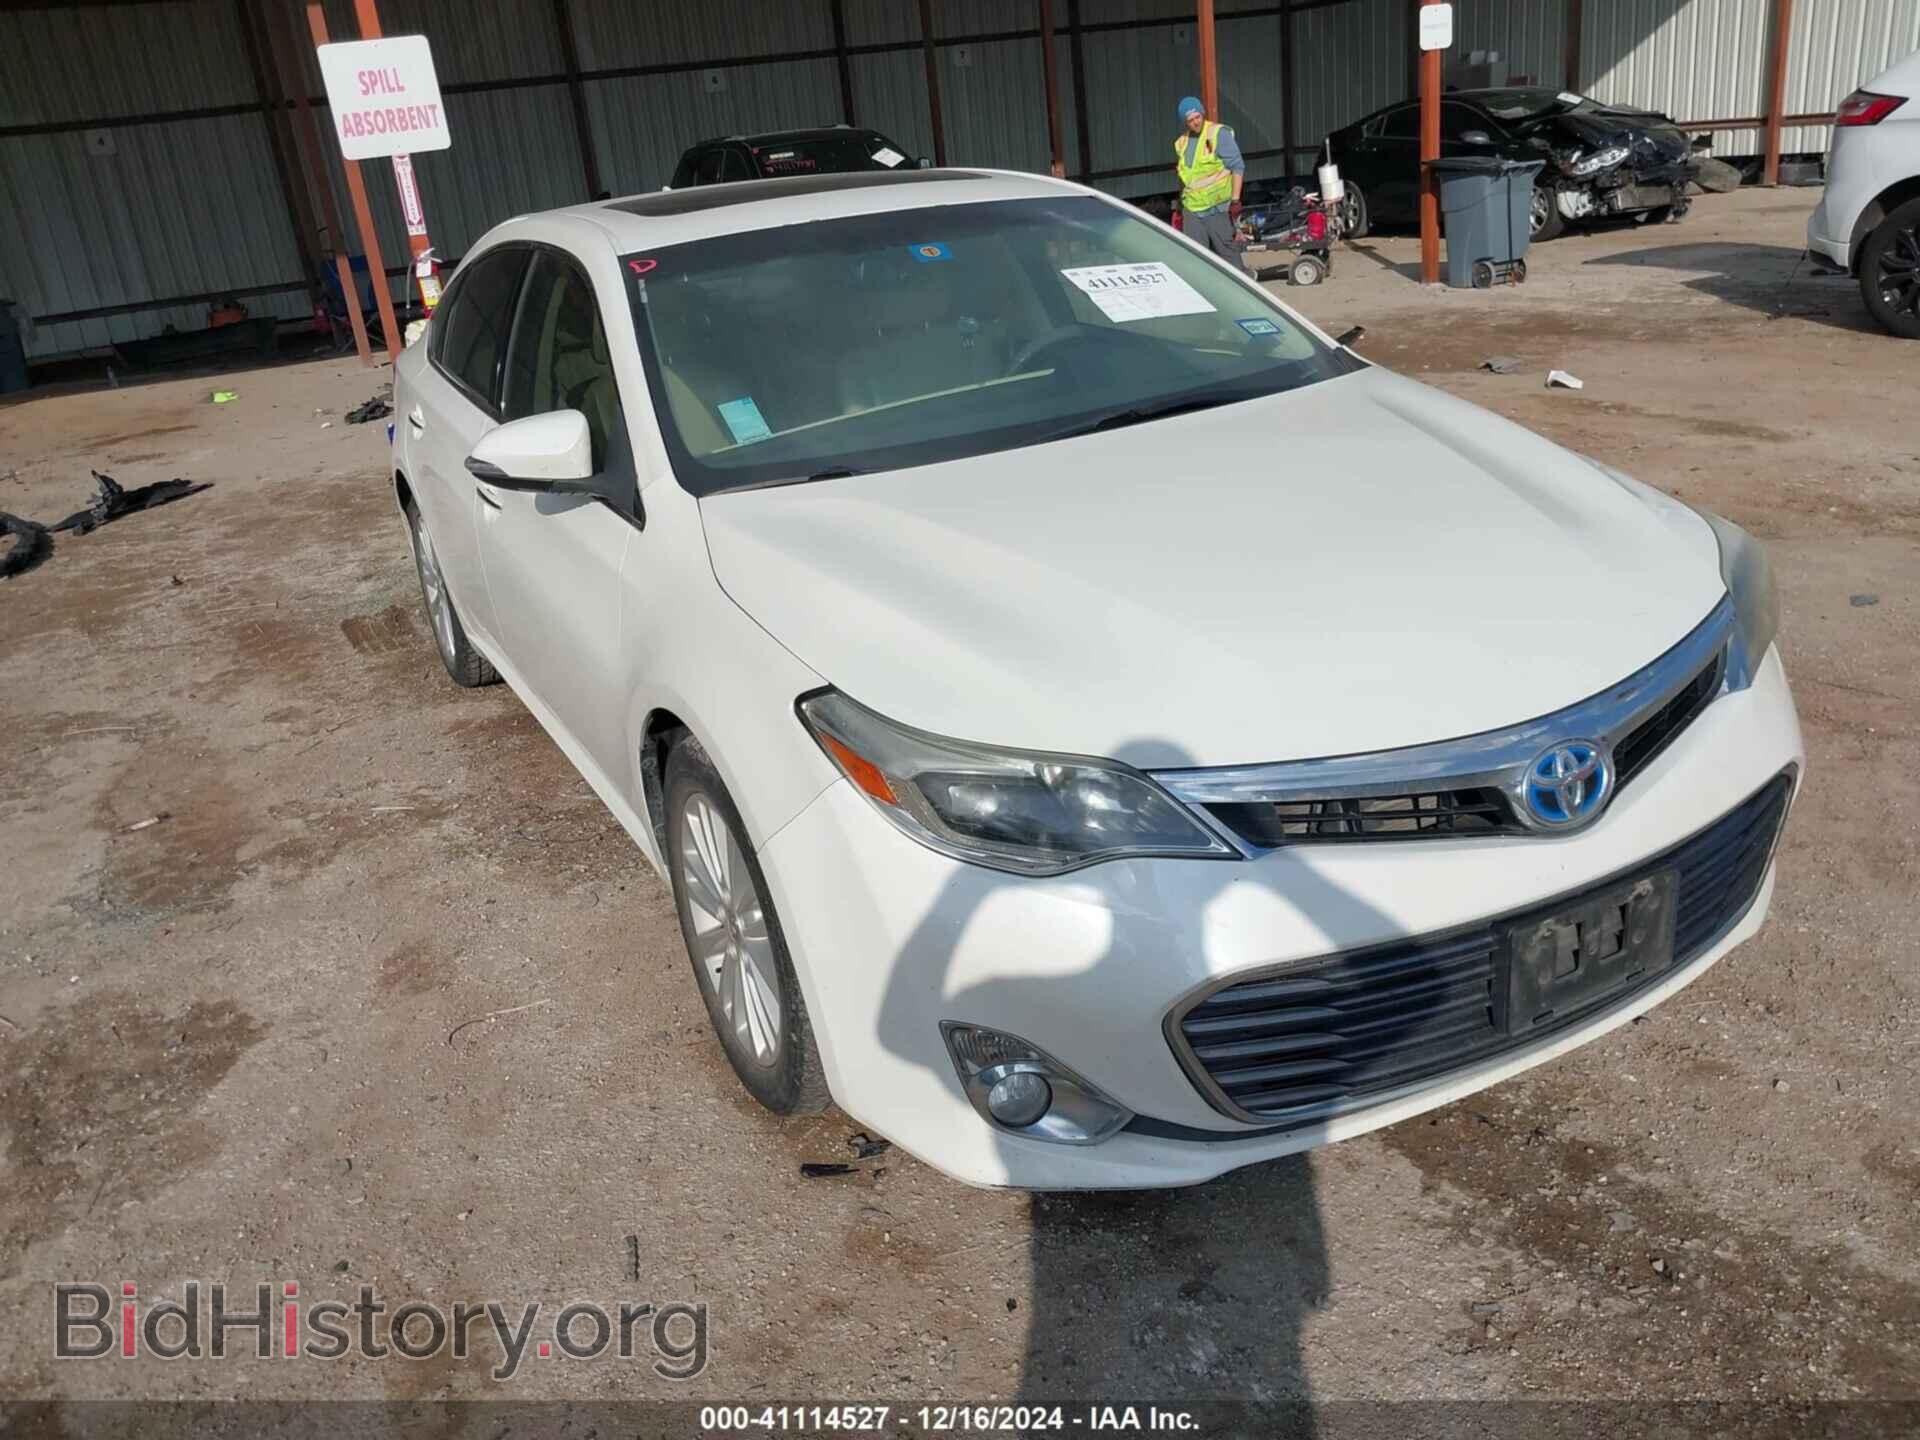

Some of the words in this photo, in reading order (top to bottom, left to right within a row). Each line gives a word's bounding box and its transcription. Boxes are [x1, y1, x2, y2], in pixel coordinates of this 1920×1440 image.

[358, 67, 405, 96] SPILL
[342, 104, 439, 138] ABSORBENT
[1088, 272, 1168, 289] 41114527
